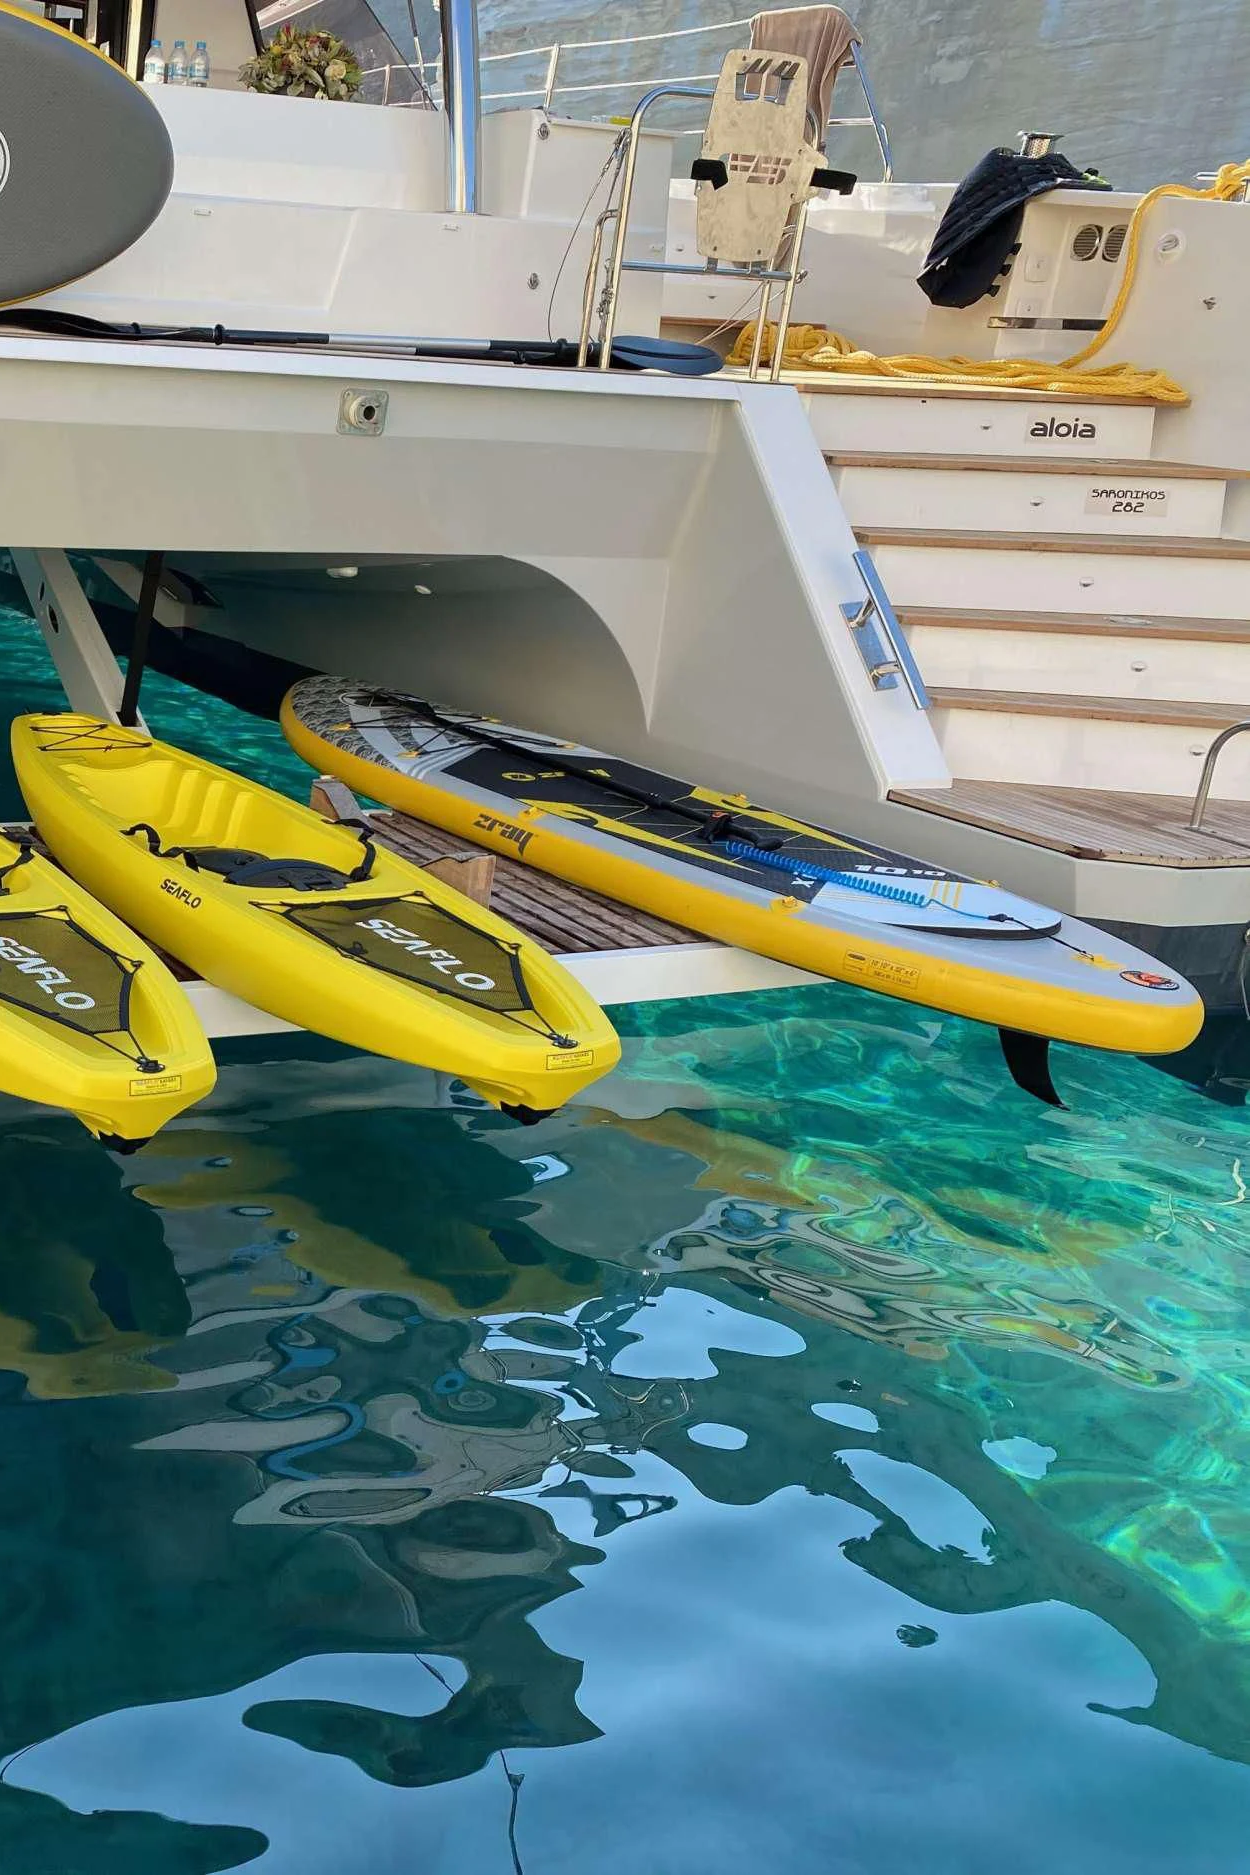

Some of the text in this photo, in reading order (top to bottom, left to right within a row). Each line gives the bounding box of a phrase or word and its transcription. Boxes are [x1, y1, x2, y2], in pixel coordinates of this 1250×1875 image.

[1030, 417, 1096, 438] aloia
[1091, 488, 1166, 500] SARONIKOS
[1112, 501, 1145, 513] 282
[473, 813, 534, 857] zray
[159, 878, 202, 910] SEAFLO
[355, 918, 495, 991] SEAFLO
